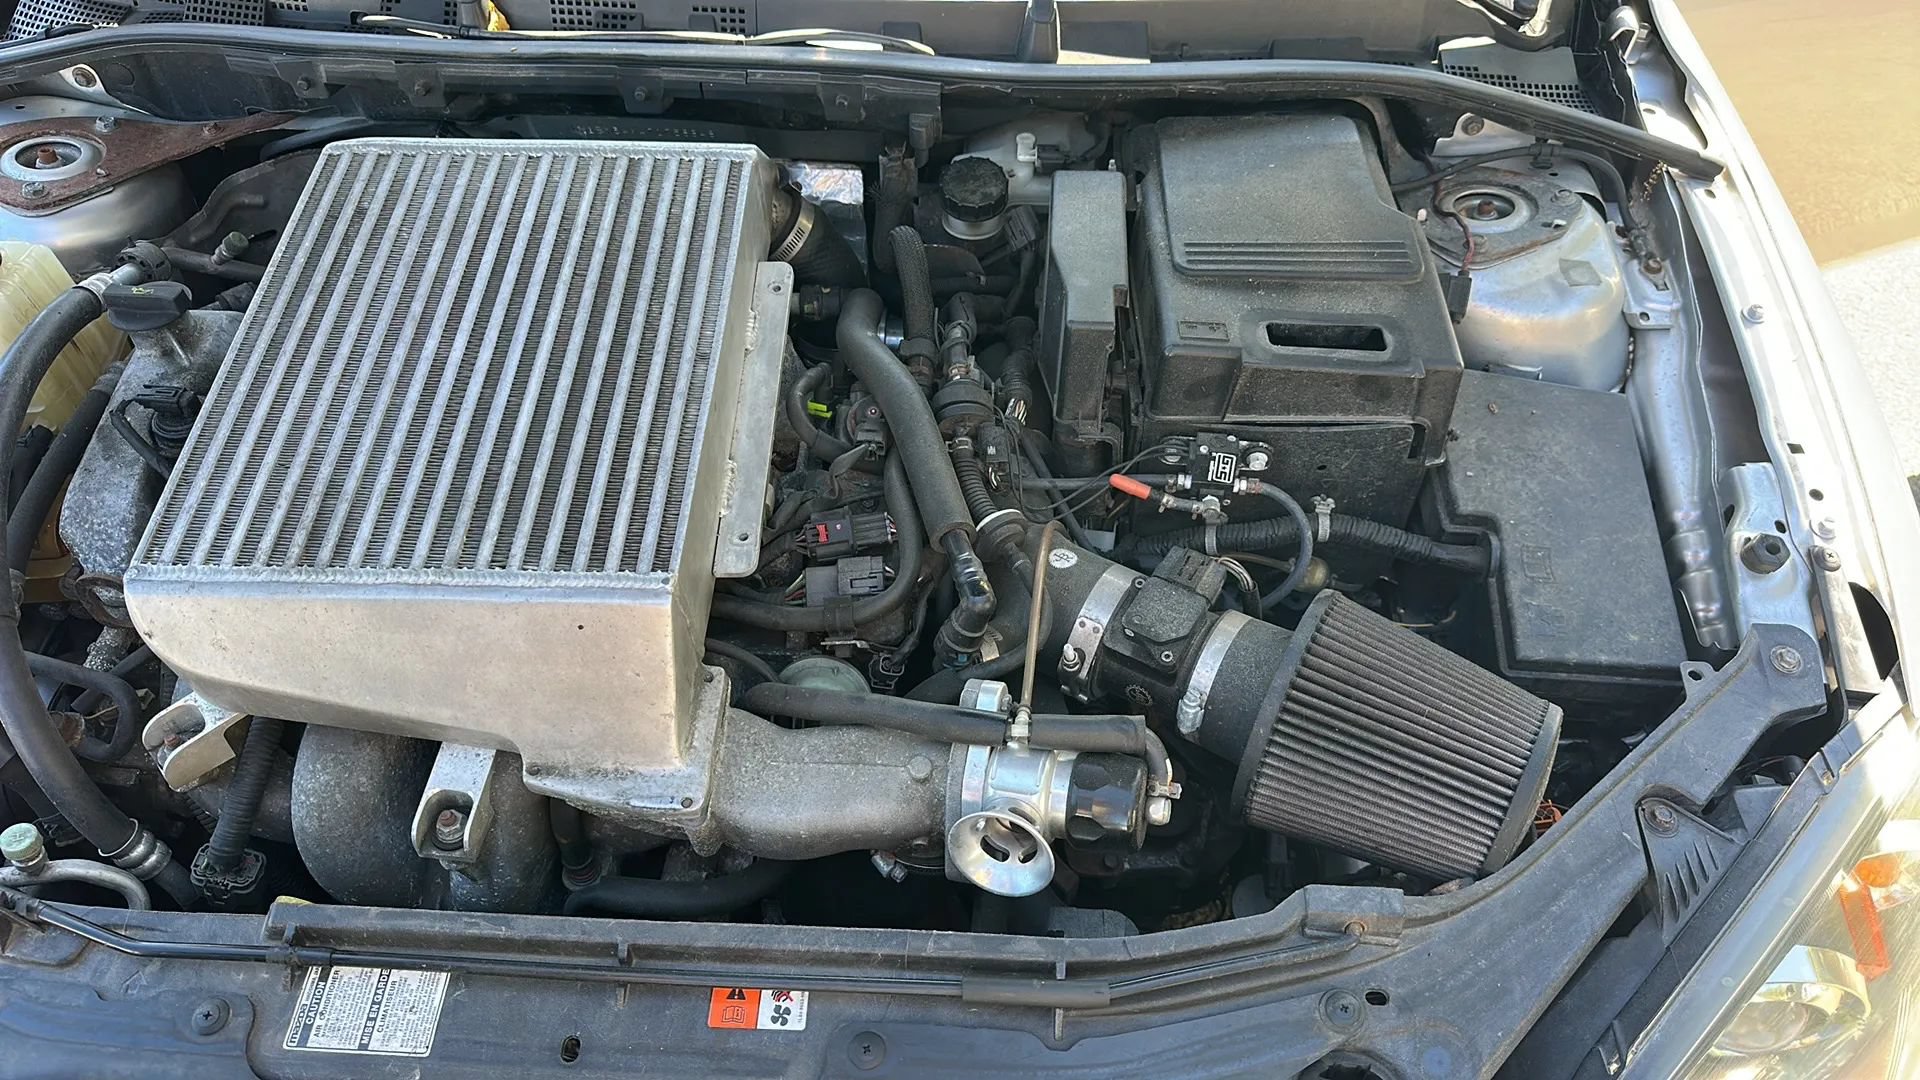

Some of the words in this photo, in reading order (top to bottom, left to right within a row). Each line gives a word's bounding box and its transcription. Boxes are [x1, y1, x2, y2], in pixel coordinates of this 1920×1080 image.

[305, 981, 326, 1025] CAUTION
[313, 1024, 323, 1038] AIR
[319, 969, 340, 1021] CONDITIONER
[374, 968, 390, 1003] GARDE
[289, 1003, 308, 1044] mazda
[369, 1004, 380, 1018] EN
[376, 980, 398, 1034] CLIMATISEUR
[361, 1019, 375, 1044] MISE
